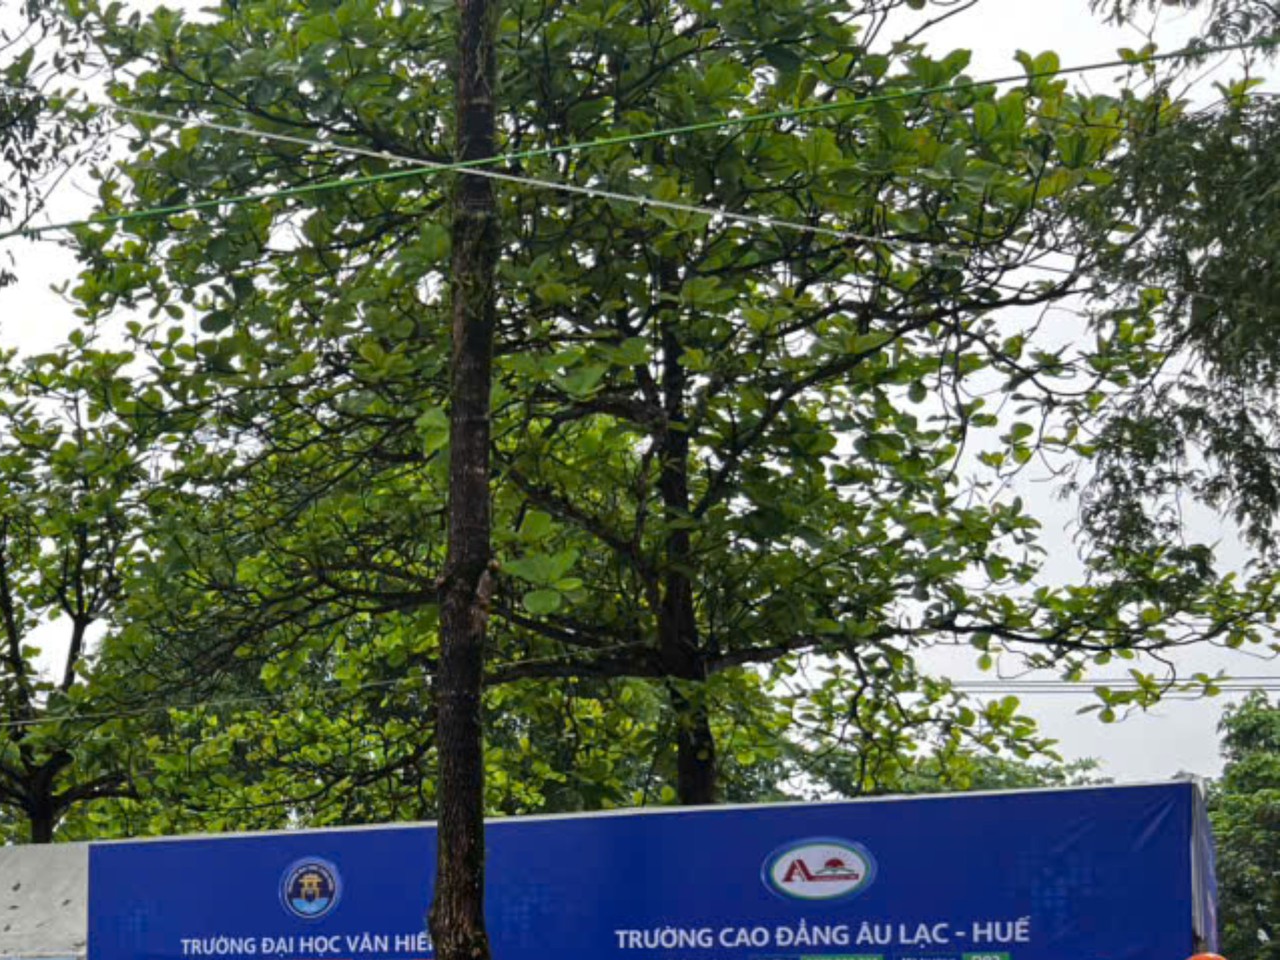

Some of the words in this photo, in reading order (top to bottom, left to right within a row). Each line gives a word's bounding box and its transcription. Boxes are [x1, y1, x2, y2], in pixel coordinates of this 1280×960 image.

[181, 934, 257, 955] TRƯỜNG
[261, 936, 294, 958] ĐẠI
[300, 935, 341, 957] HỌC
[347, 932, 389, 952] VĂN
[615, 926, 713, 949] TRƯỜNG
[719, 927, 769, 947] CAO
[775, 918, 849, 947] ĐẲNG
[856, 921, 891, 945] ÂU
[900, 923, 949, 949] LẠC
[973, 915, 1030, 943] HUẾ
